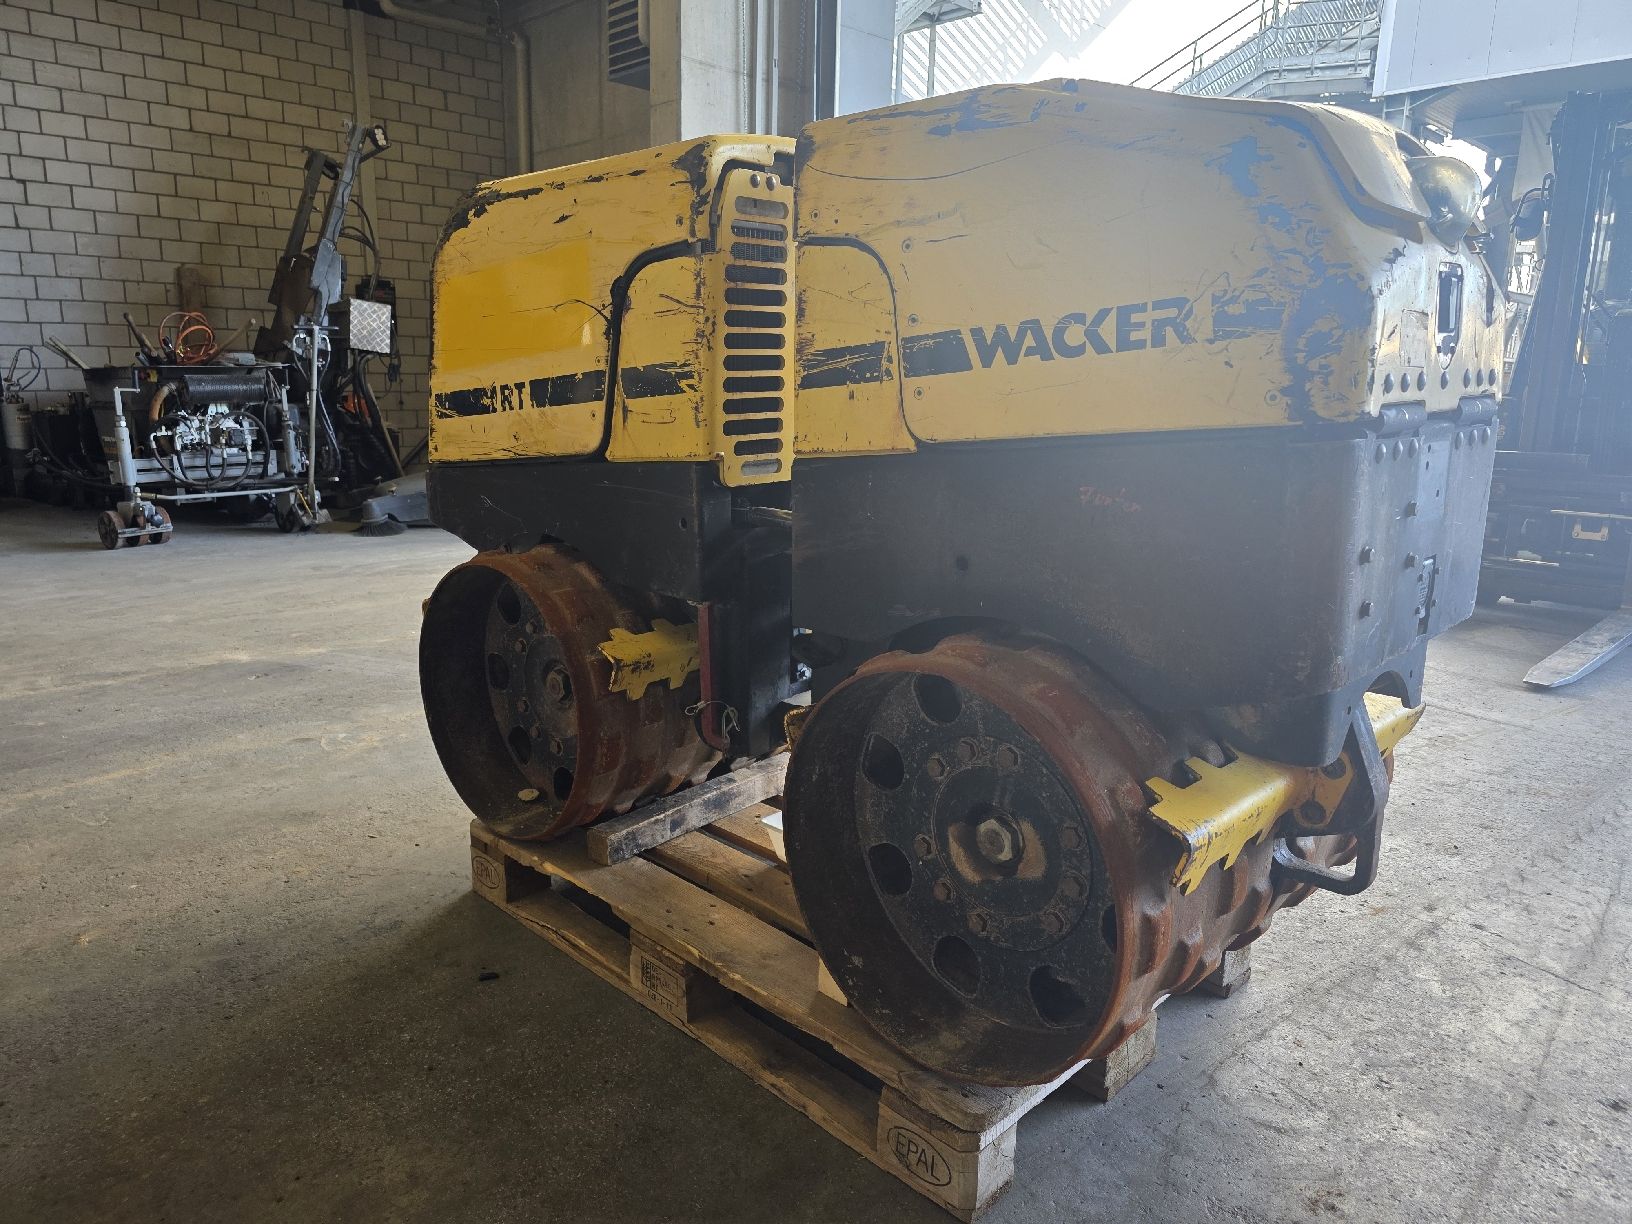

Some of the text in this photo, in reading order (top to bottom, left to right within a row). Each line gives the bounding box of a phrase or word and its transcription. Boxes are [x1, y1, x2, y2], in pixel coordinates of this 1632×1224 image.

[969, 296, 1198, 369] WACKER
[499, 381, 526, 412] RT
[896, 1131, 941, 1182] EPAL
